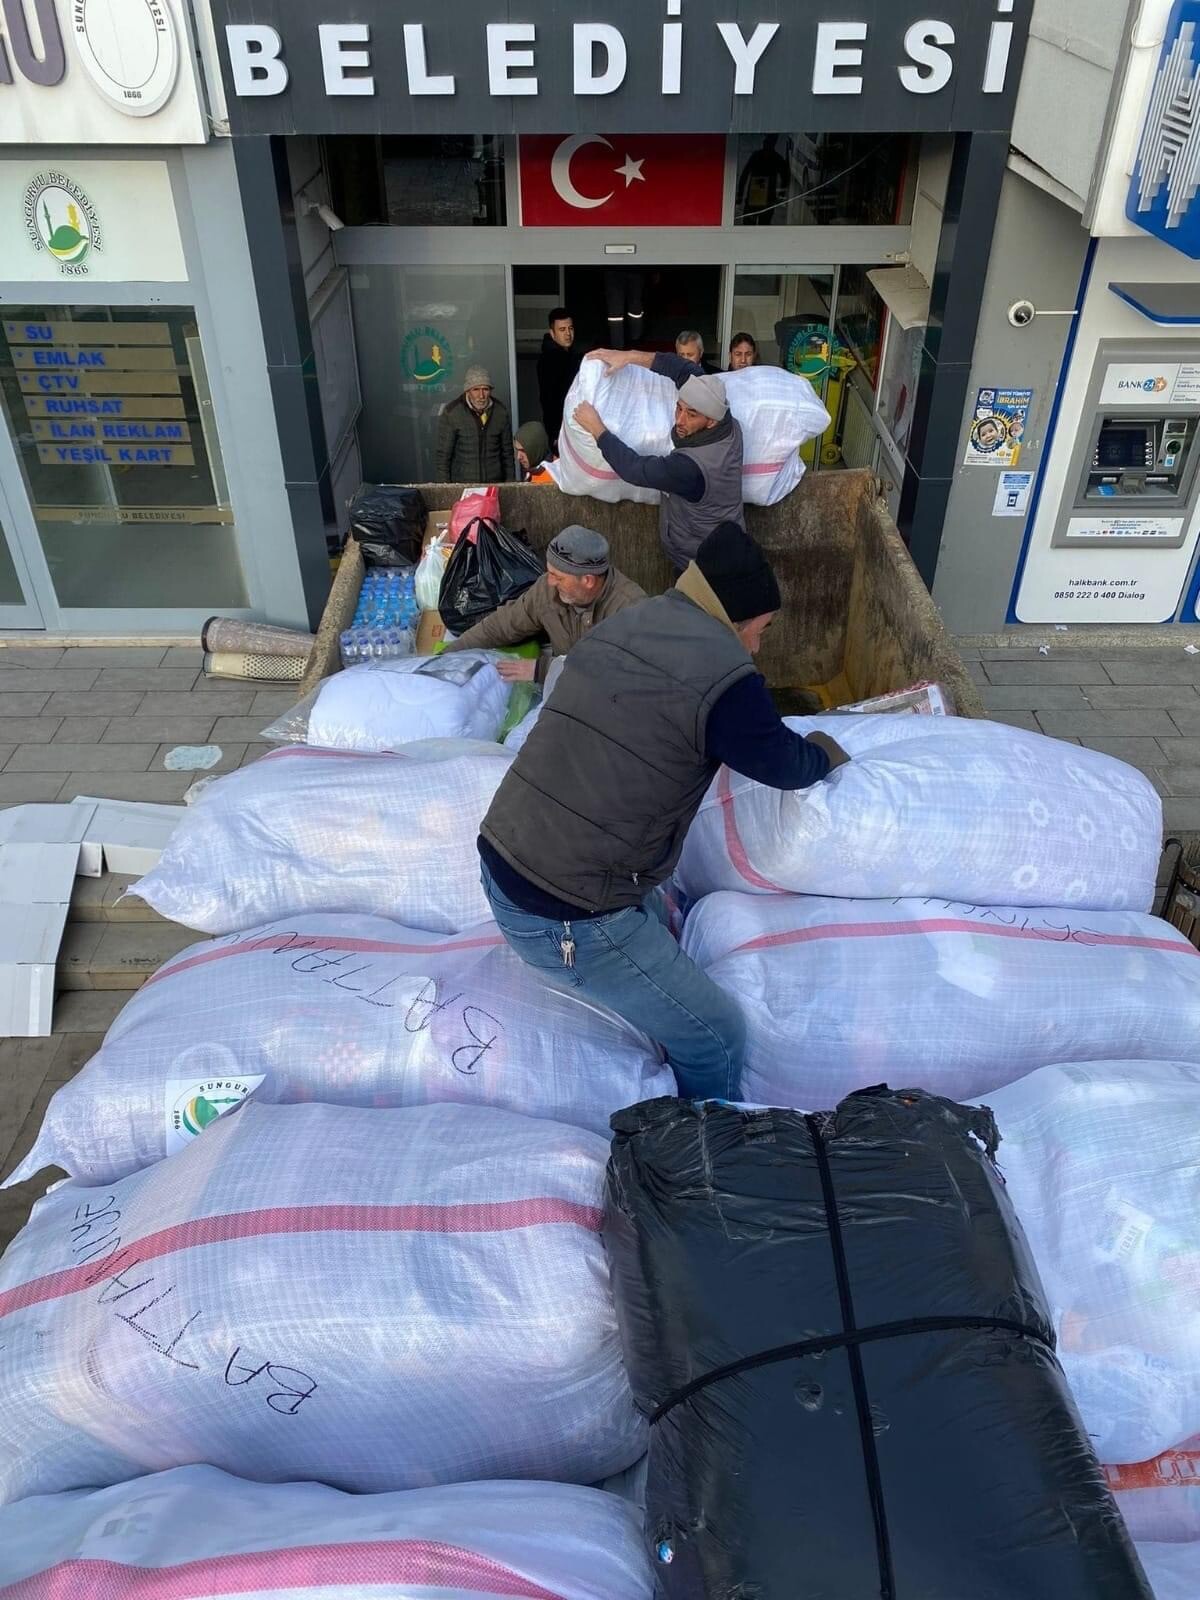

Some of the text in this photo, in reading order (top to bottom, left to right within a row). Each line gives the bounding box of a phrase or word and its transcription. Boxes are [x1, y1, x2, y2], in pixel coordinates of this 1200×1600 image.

[226, 0, 1013, 97] BELEDİYESİ
[60, 264, 89, 275] 1866
[25, 325, 53, 340] SU
[33, 351, 105, 366] EMLAK
[38, 375, 79, 391] ÇTV
[46, 400, 123, 414] RUHSAT
[103, 425, 183, 438] REKLAM
[56, 447, 173, 463] YEŞİL KART
[1118, 592, 1145, 600] Dialog
